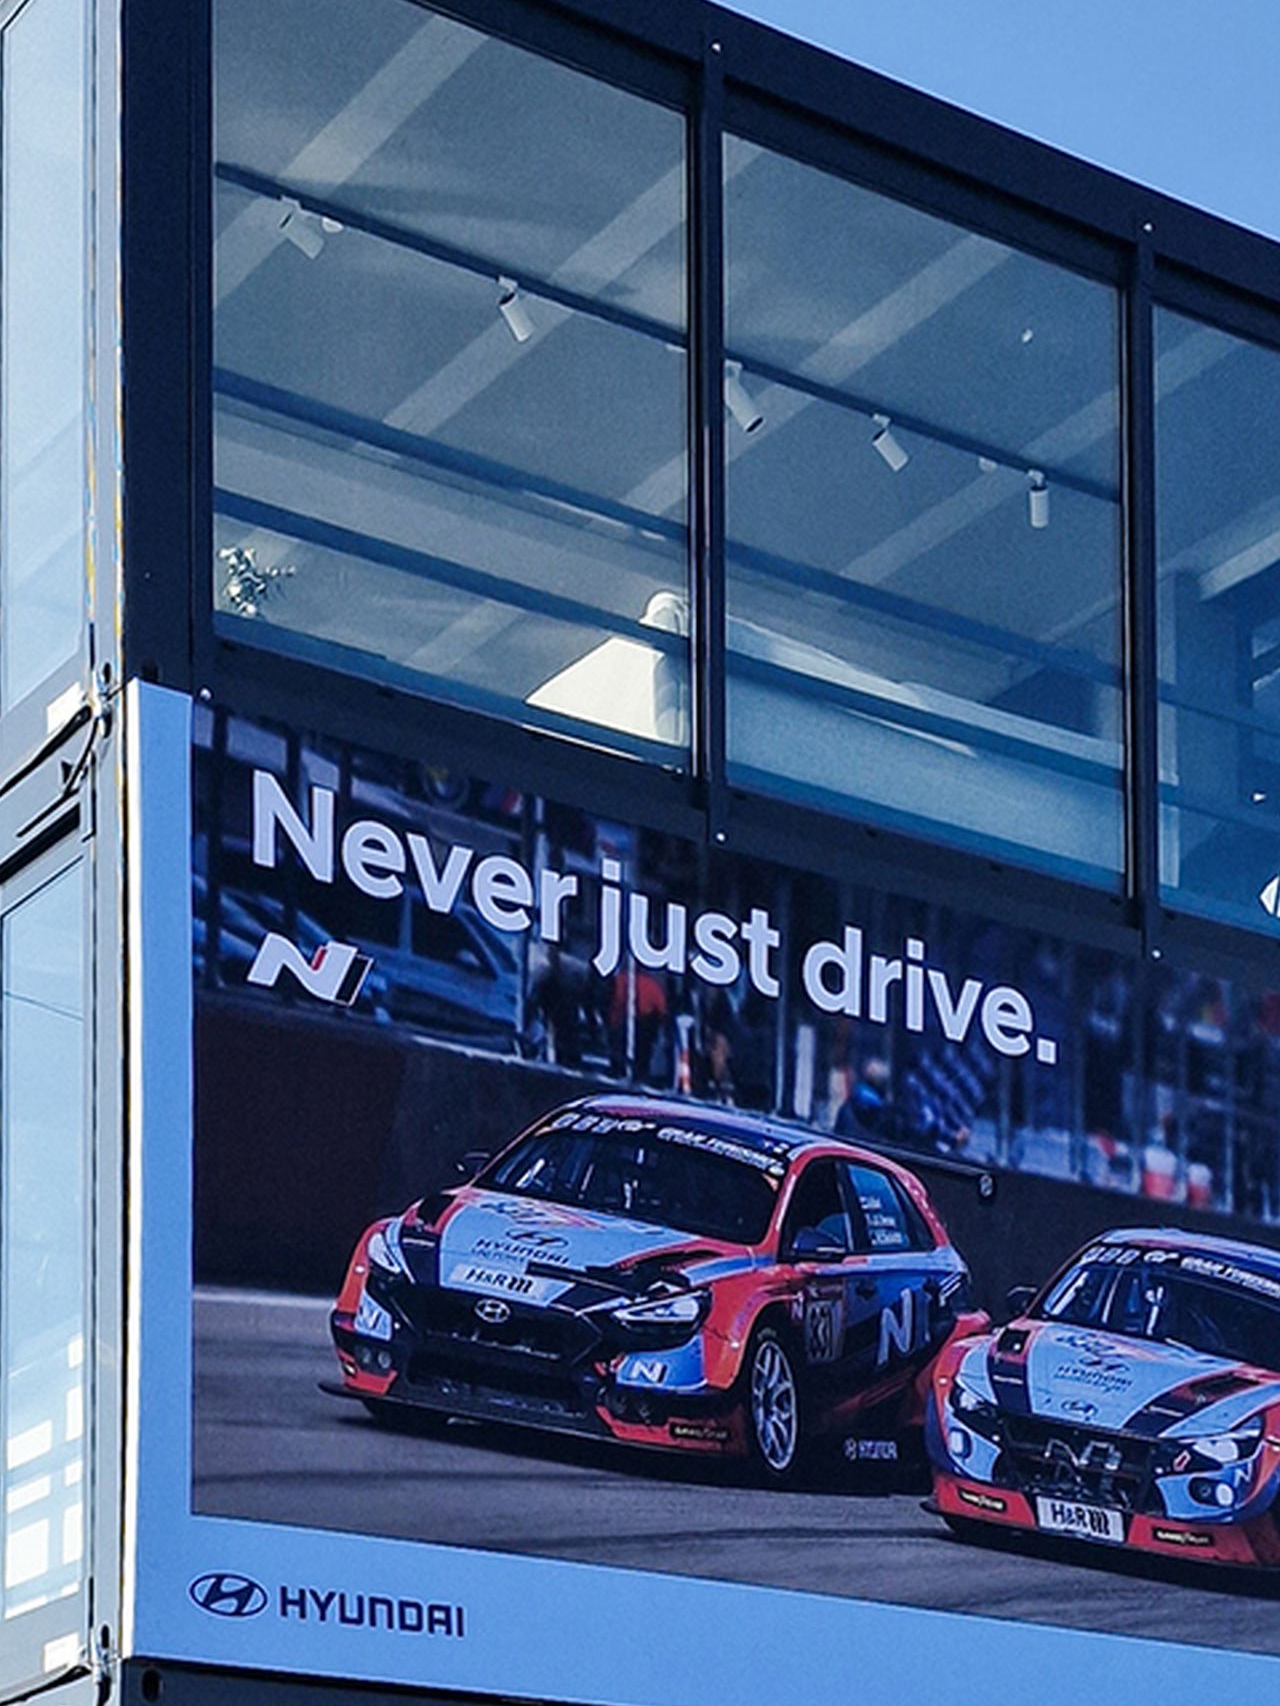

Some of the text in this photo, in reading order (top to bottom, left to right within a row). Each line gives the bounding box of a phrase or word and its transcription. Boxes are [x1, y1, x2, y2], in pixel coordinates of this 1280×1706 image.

[252, 768, 1058, 1064] Never just drive.
[279, 1585, 465, 1638] HYUNDAI
